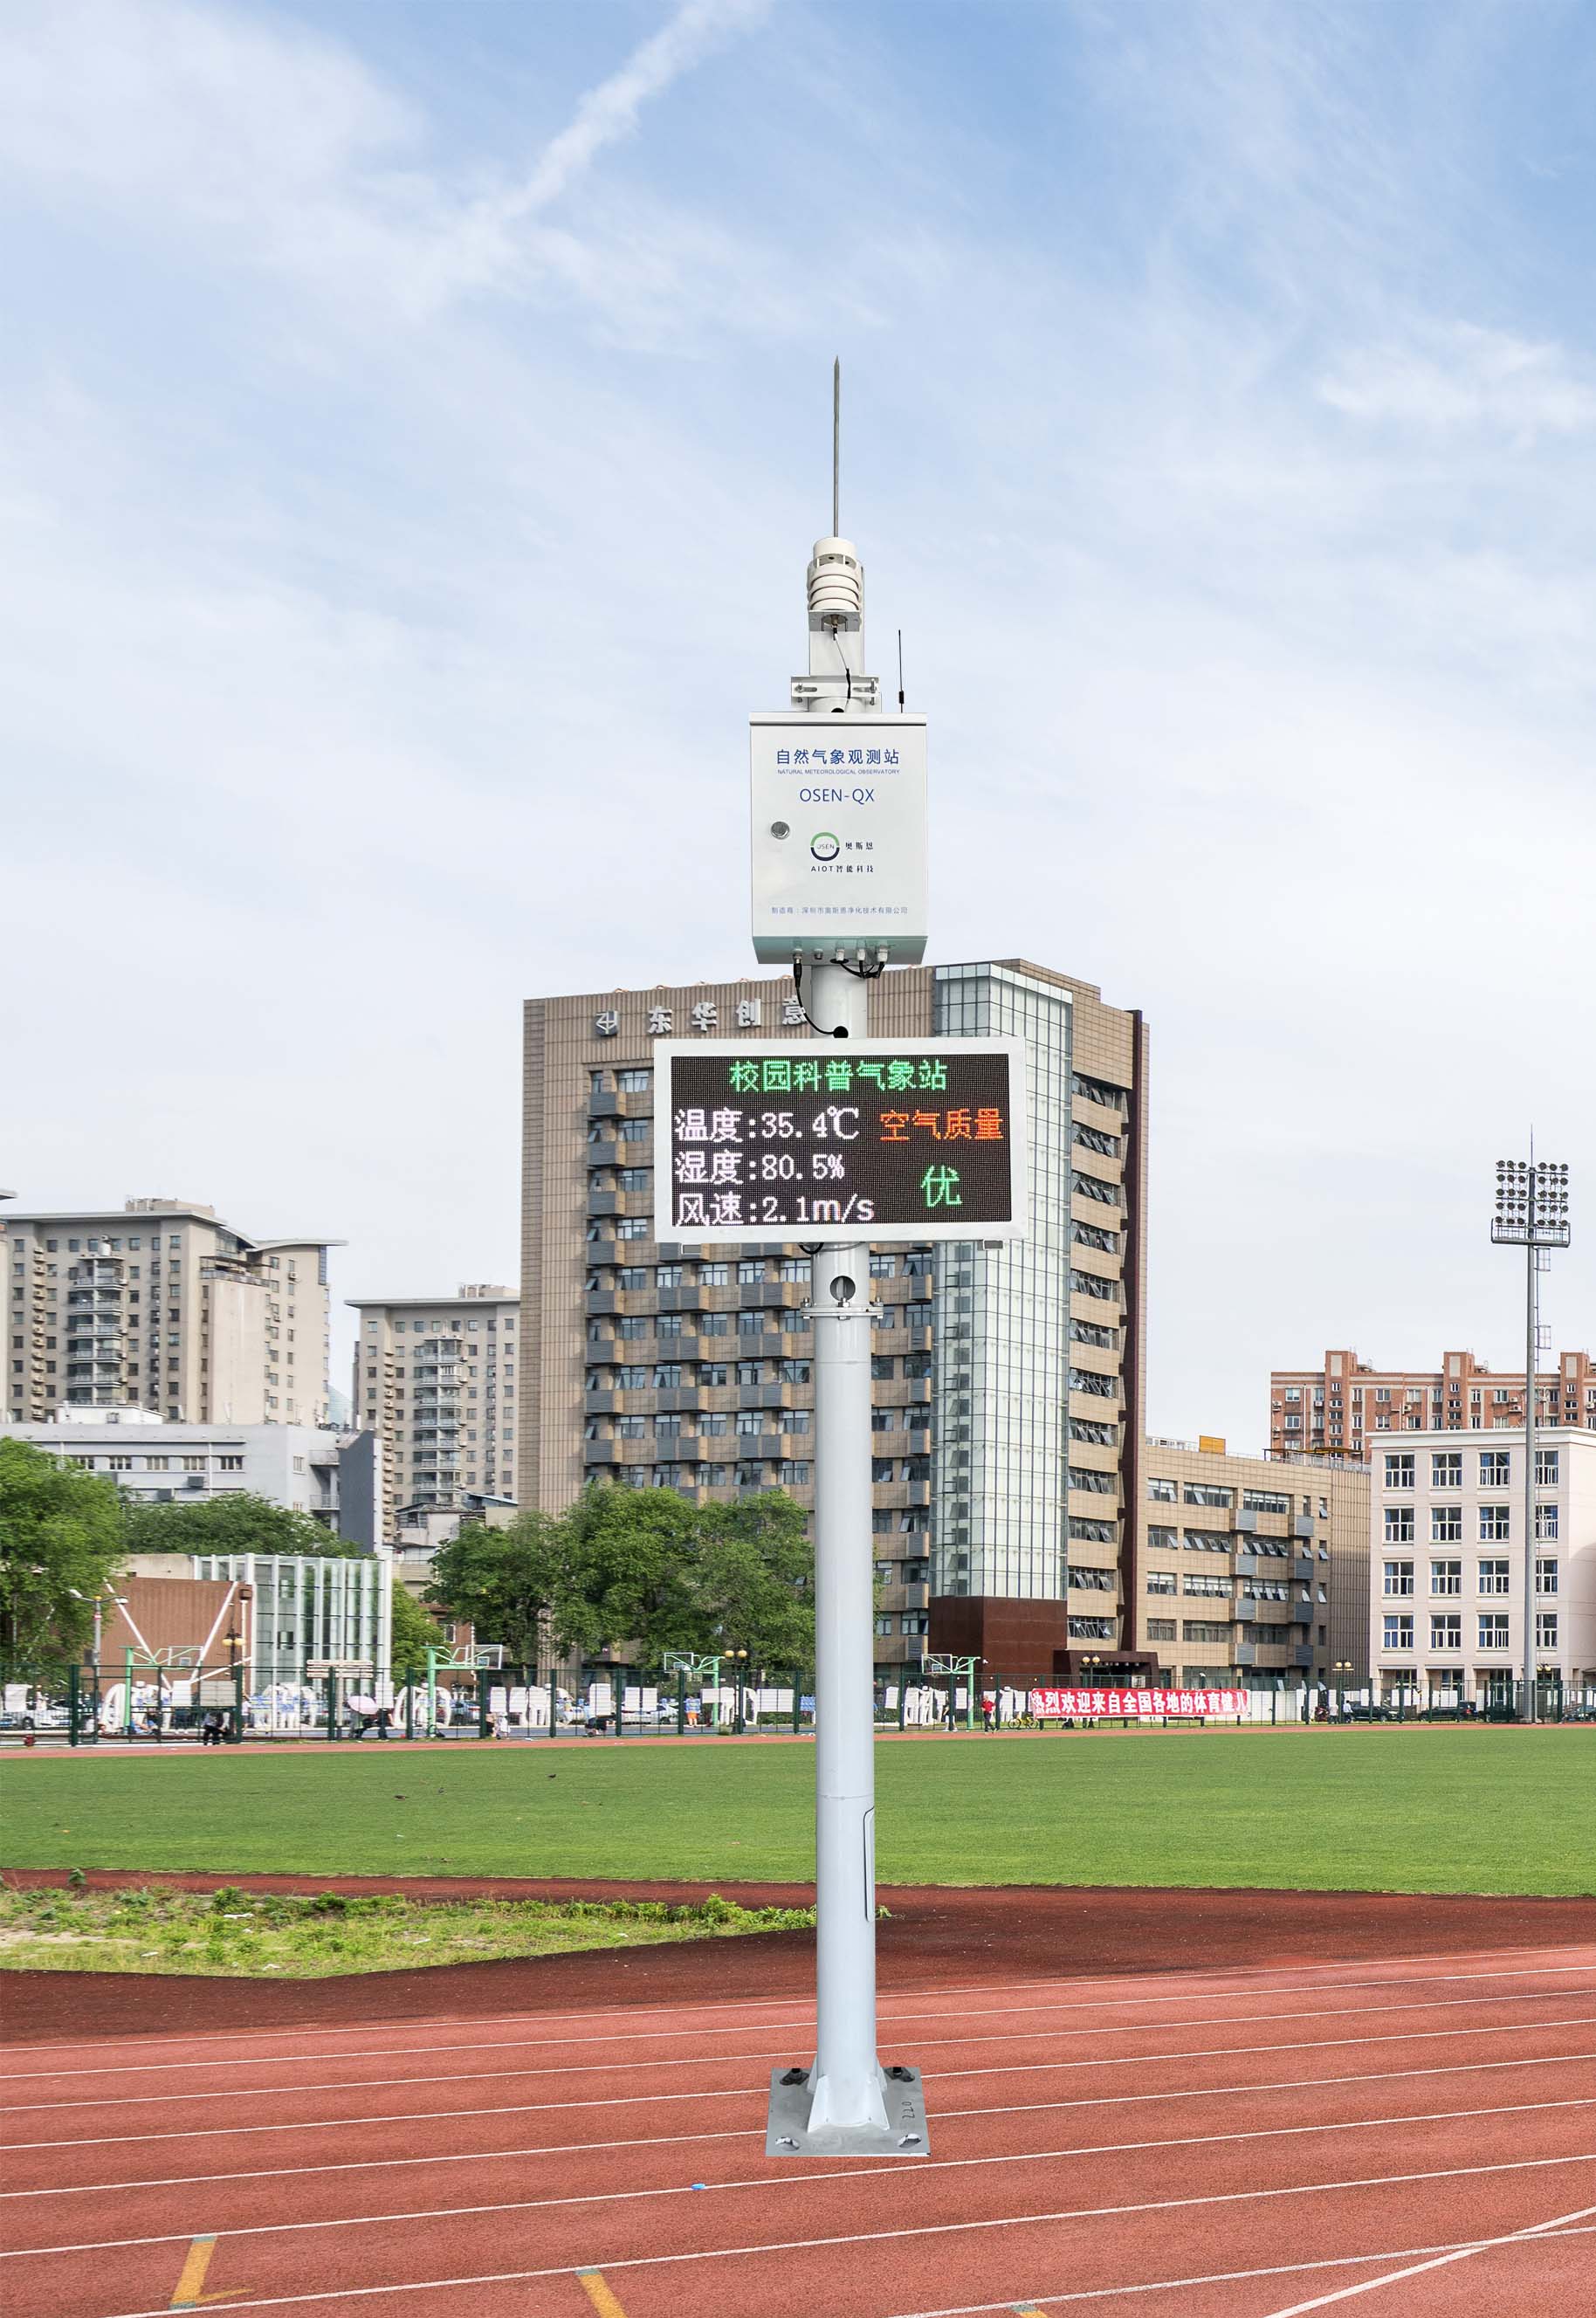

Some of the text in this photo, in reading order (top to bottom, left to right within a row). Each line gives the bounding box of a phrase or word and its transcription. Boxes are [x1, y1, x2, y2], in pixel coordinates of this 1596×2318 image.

[777, 748, 900, 765] 自然气象观测站
[799, 788, 875, 805] OSEN-QX
[729, 1059, 947, 1093] 校园科普气象站
[879, 1107, 1005, 1142] 空气质量
[920, 1165, 963, 1208] 优
